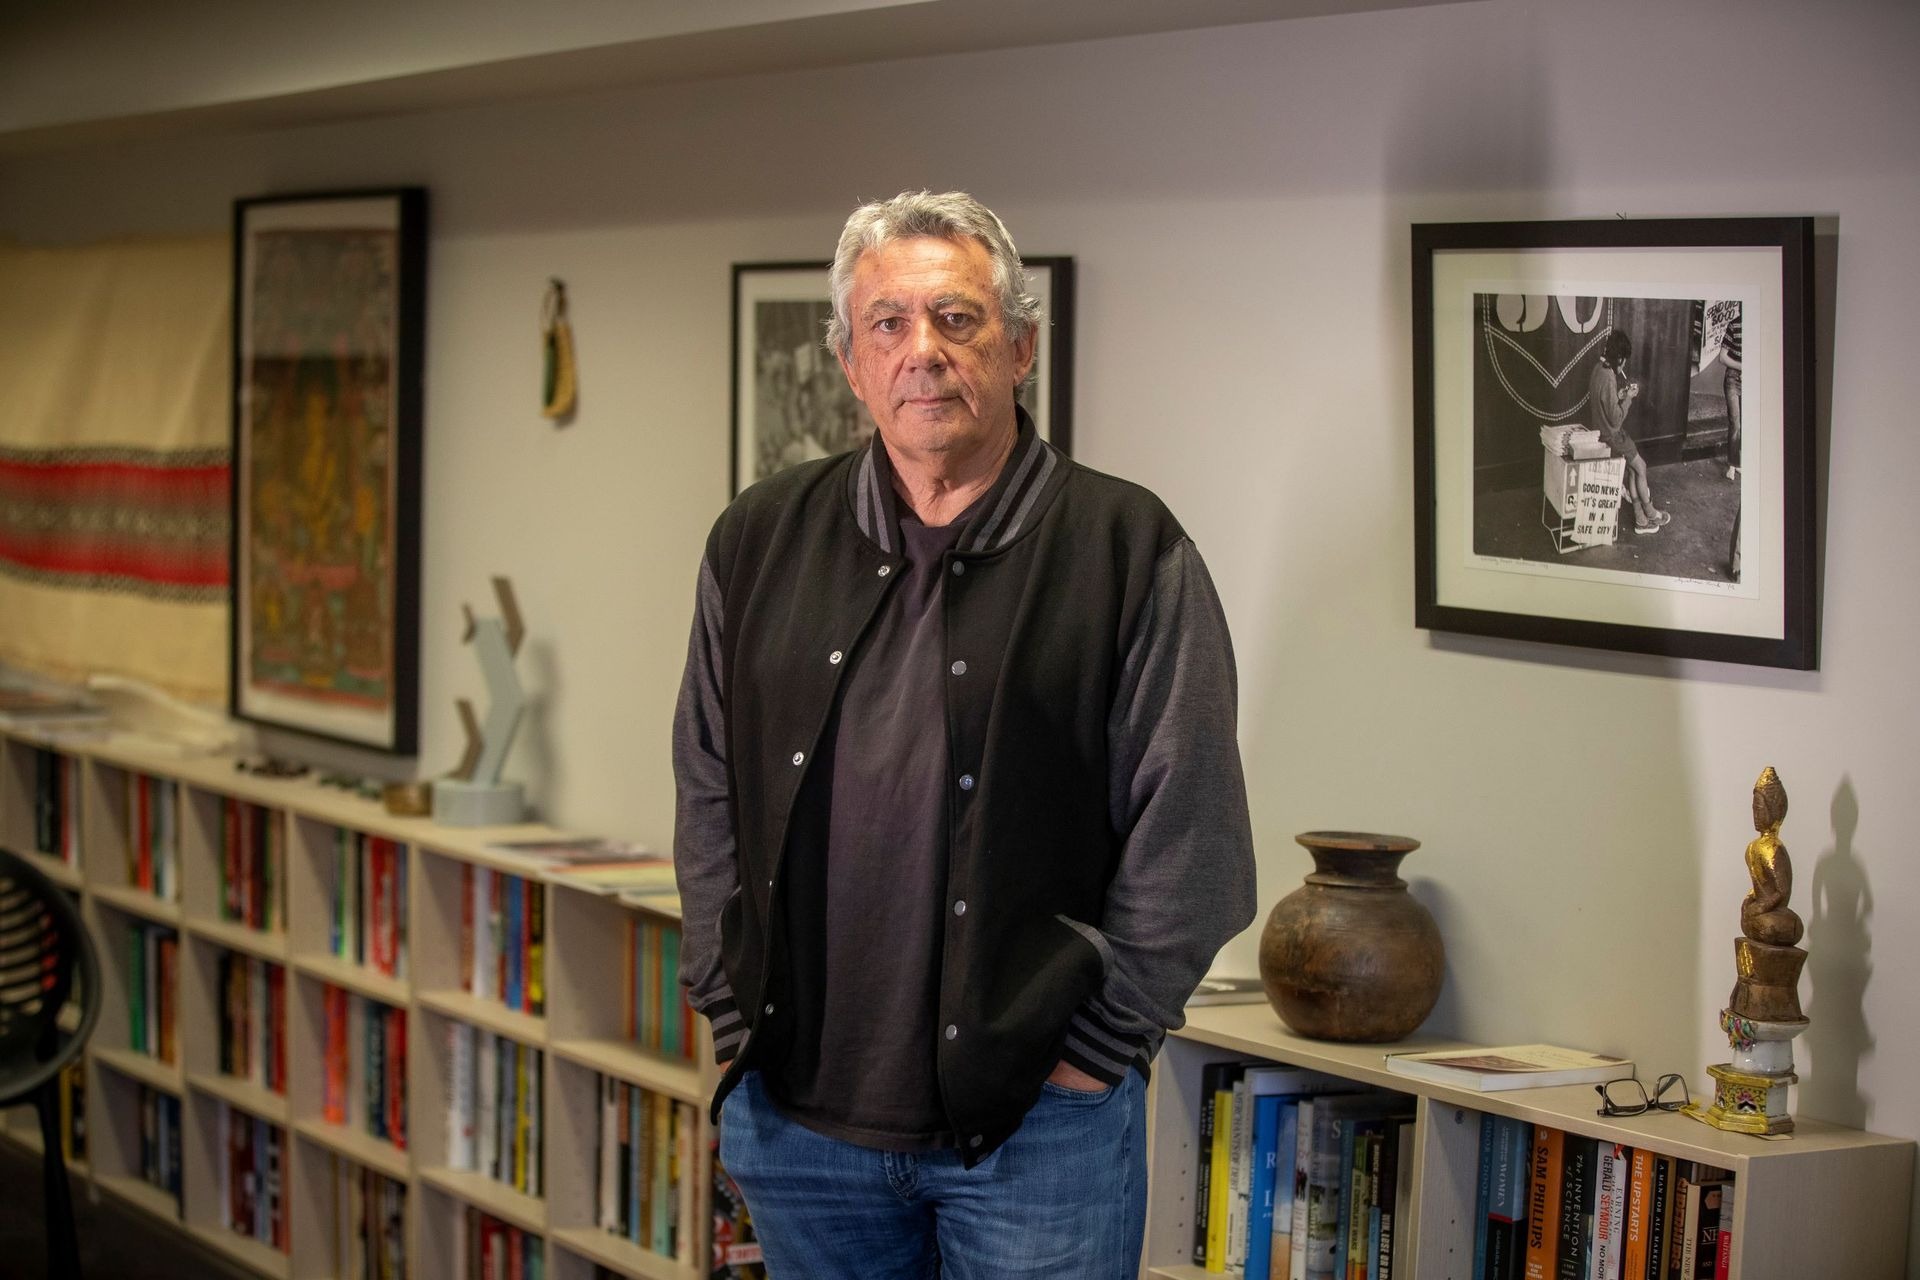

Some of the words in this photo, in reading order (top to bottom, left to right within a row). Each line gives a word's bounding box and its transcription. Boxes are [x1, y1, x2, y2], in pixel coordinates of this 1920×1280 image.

[1583, 483, 1600, 493] GOOD
[1601, 485, 1620, 496] NEWS
[1589, 512, 1597, 521] IN
[1600, 513, 1605, 521] A
[1598, 500, 1617, 509] GREAT
[1577, 525, 1593, 534] SAFE
[1597, 526, 1611, 534] CITY
[1233, 1092, 1243, 1150] MERCHANTS
[1485, 1120, 1493, 1153] DOOR
[1232, 1150, 1241, 1162] OF
[1372, 1144, 1380, 1172] BRUCE
[1536, 1146, 1549, 1179] SAM
[1575, 1154, 1584, 1173] The
[1634, 1154, 1645, 1178] THE
[1230, 1165, 1240, 1192] DEBT
[1354, 1174, 1362, 1187] THE
[1482, 1163, 1491, 1196] DOOR
[1566, 1165, 1574, 1177] of
[1602, 1155, 1613, 1192] GERALD
[1371, 1174, 1379, 1206] JESSON
[1497, 1162, 1508, 1207] WOMEN
[1657, 1174, 1665, 1193] MAN
[1351, 1188, 1361, 1227] CHOCOLATE
[1531, 1183, 1546, 1249] PHILLIPS
[1563, 1181, 1573, 1241] SCIENCE
[1613, 1187, 1622, 1234] EARNING
[1630, 1180, 1642, 1242] UPSTARTS
[1655, 1196, 1663, 1213] FOR
[1380, 1214, 1391, 1232] WIN,
[1570, 1177, 1582, 1257] INVENTION
[1599, 1193, 1611, 1241] SEYMOUR
[1654, 1216, 1662, 1231] ALL
[1350, 1229, 1360, 1251] WARS
[1380, 1233, 1391, 1253] LOSE
[1599, 1244, 1606, 1257] NO
[1685, 1237, 1693, 1254] THE
[1720, 1235, 1730, 1269] WAITANGI
[1380, 1254, 1389, 1266] OR
[1651, 1235, 1660, 1276] MARKETS
[1684, 1256, 1692, 1275] NEW
